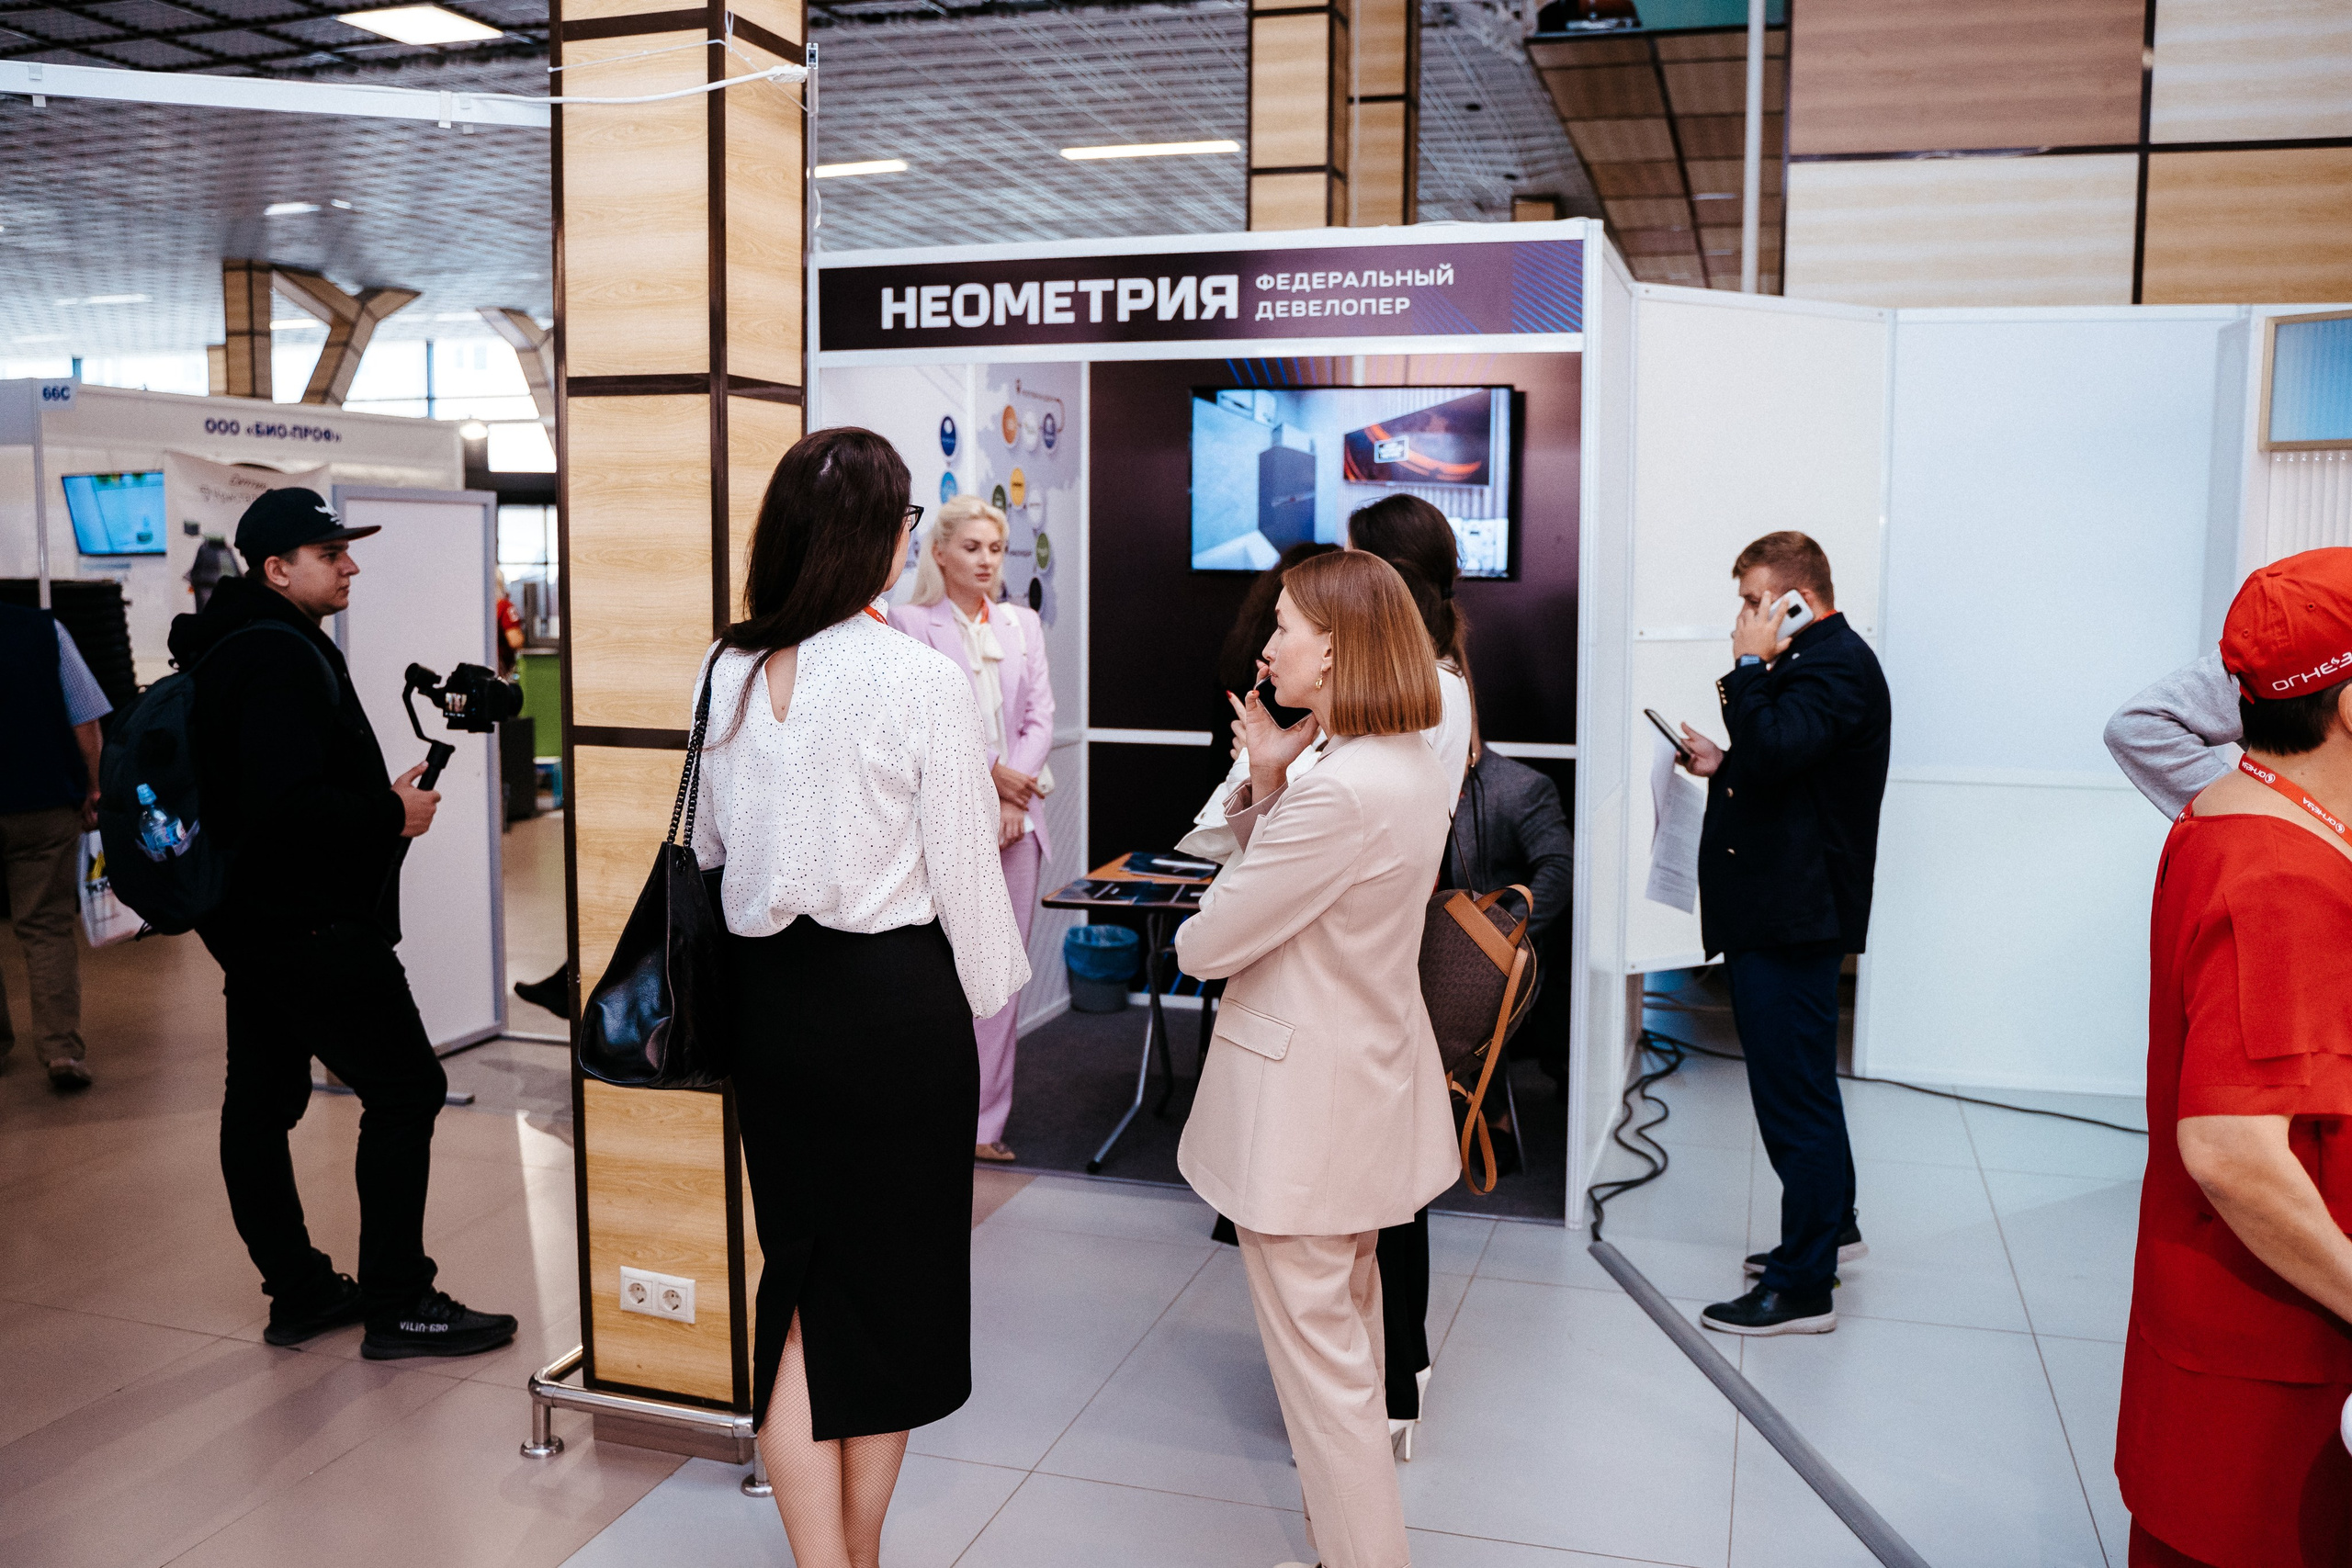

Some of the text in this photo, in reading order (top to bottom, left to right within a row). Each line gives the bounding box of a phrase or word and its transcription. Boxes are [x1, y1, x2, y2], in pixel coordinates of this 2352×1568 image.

[1255, 263, 1454, 293] ФЕДЕРАЛЬНЫЙ
[881, 275, 1238, 330] НЕОМЕТРИЯ
[1255, 297, 1410, 321] ДЕВЕЛОПЕР
[205, 418, 240, 435] ООО
[2302, 796, 2336, 826] ОГНЕЗА
